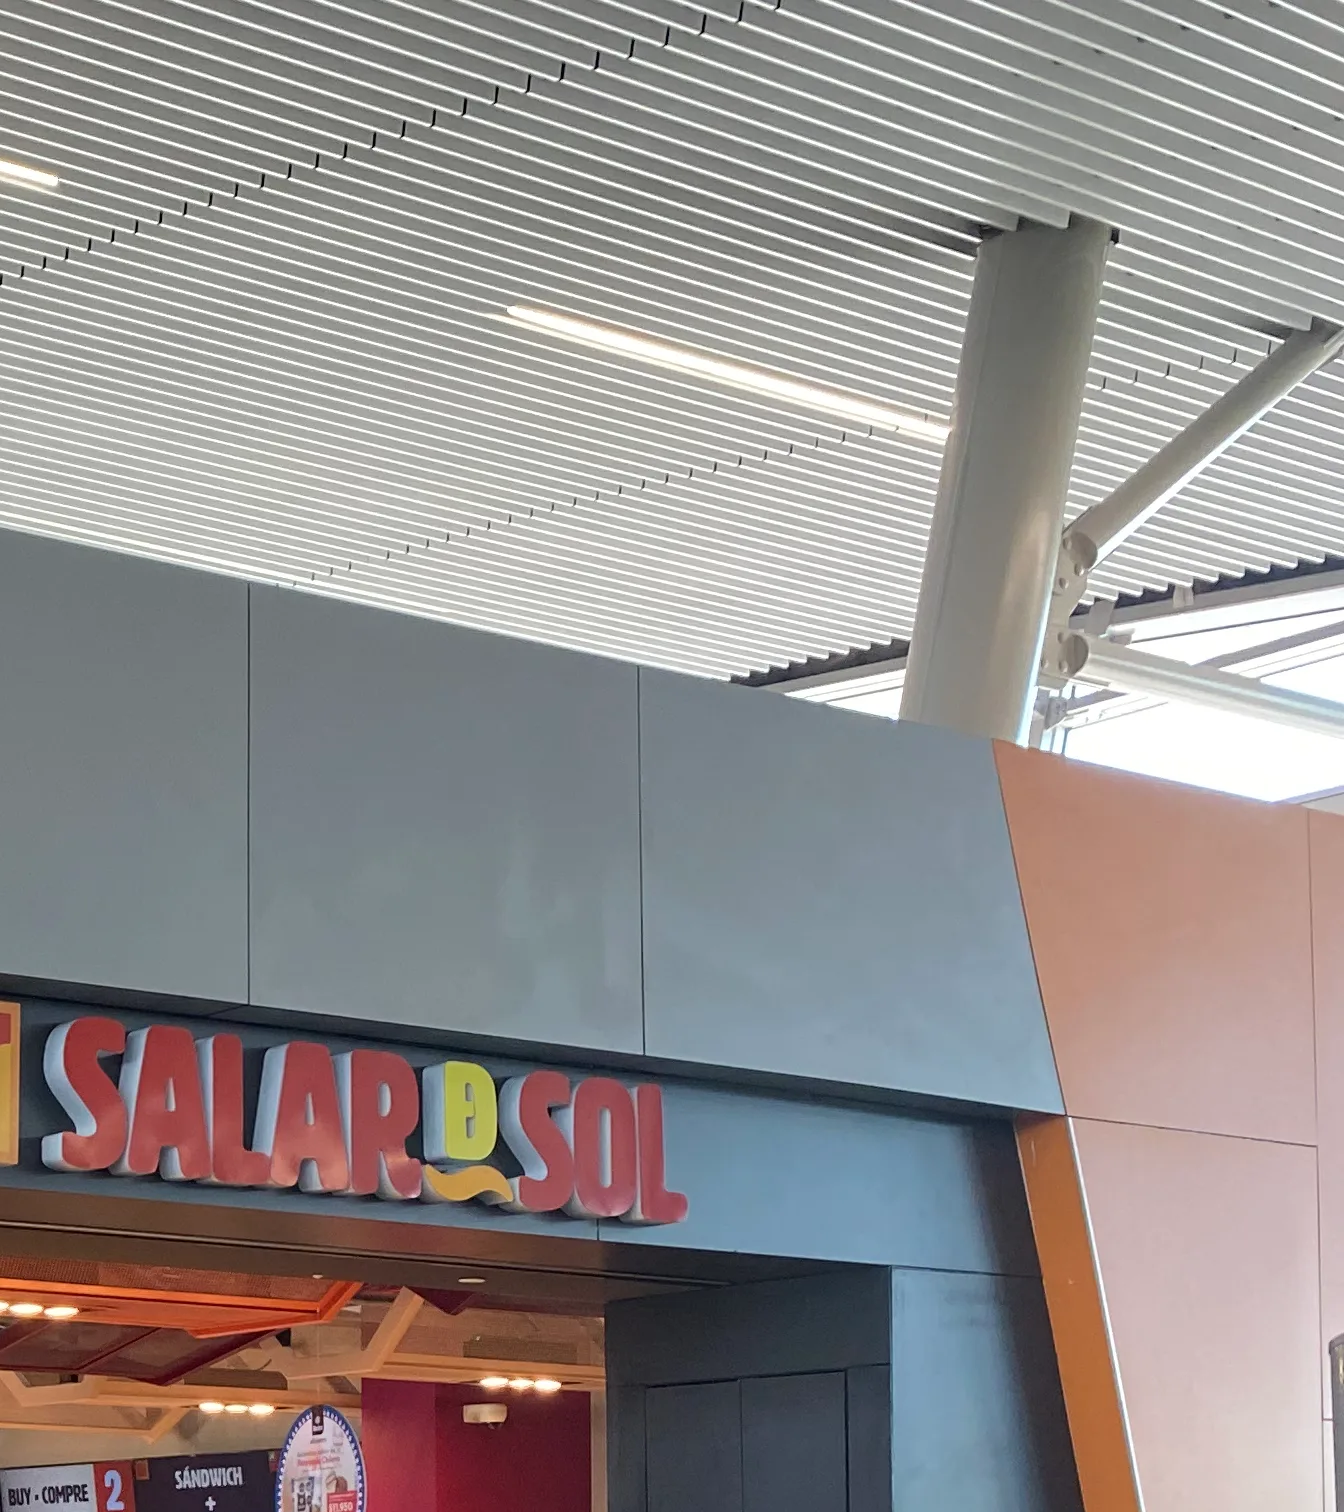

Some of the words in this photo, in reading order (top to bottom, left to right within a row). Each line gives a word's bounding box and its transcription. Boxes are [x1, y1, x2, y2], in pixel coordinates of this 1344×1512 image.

[43, 1017, 422, 1200] SALAR
[502, 1070, 690, 1224] SOL
[104, 1470, 125, 1511] 2
[174, 1466, 243, 1489] SÁNDWICH
[8, 1488, 31, 1506] BUY
[42, 1484, 89, 1504] COMPRE
